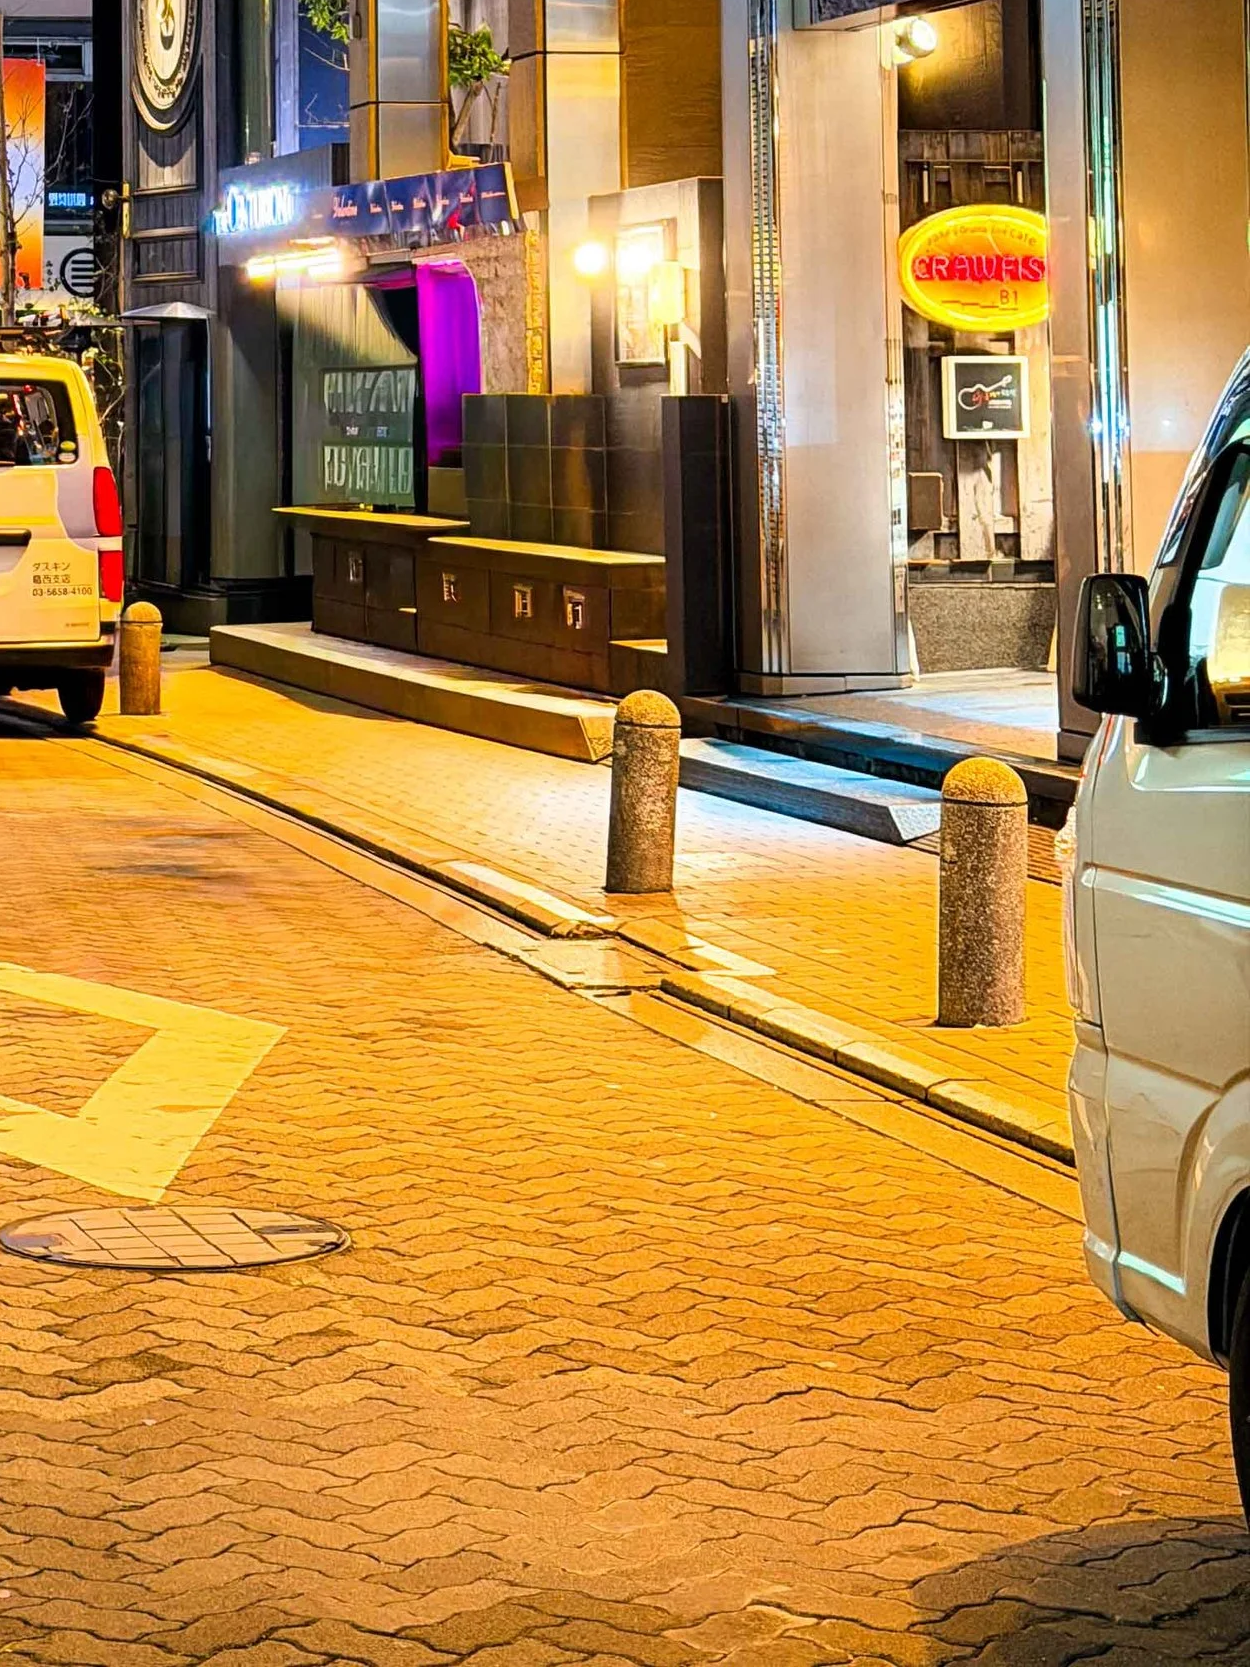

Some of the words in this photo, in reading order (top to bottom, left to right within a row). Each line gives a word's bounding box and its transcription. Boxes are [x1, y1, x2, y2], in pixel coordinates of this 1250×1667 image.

[913, 254, 1046, 282] CRAWFIS
[1000, 289, 1019, 306] B1
[32, 562, 71, 572] ダスキン
[32, 586, 93, 597] 03-5658-4100
